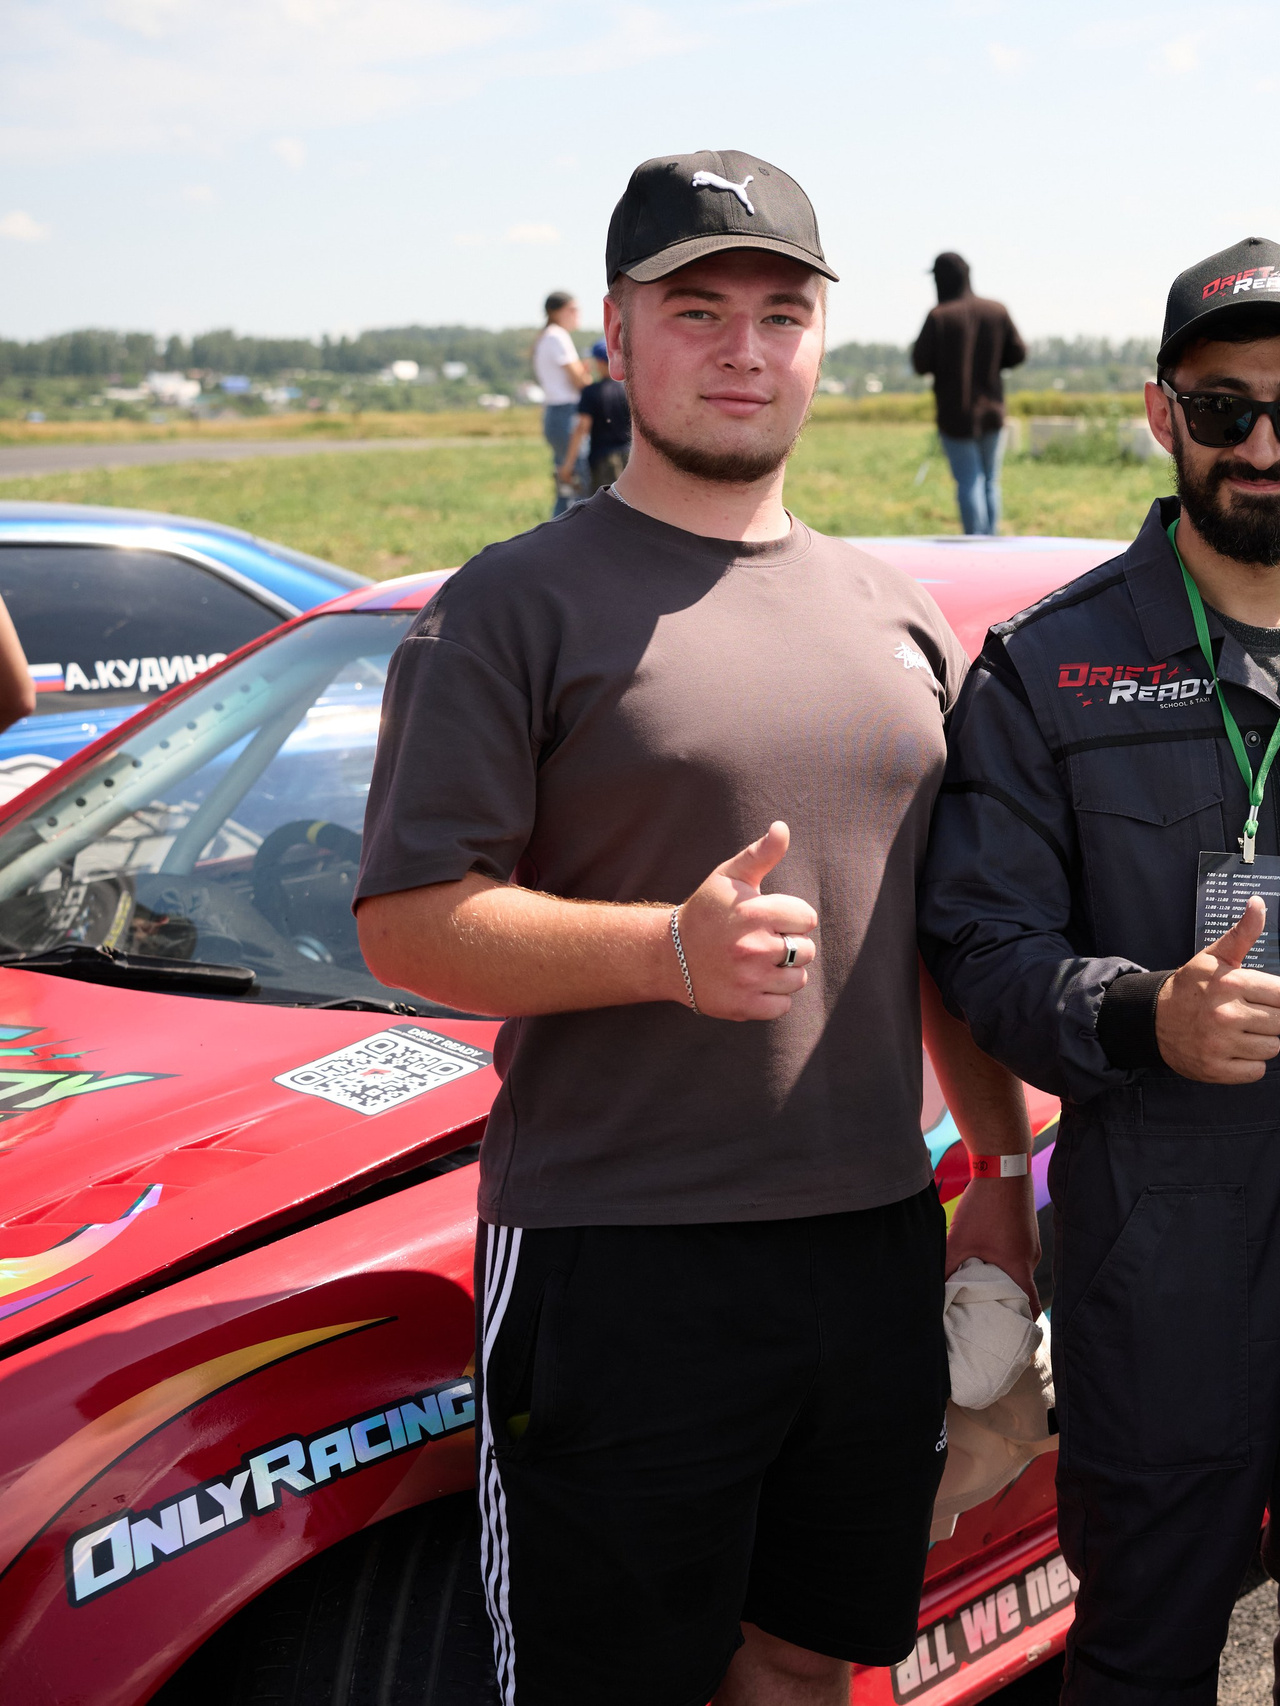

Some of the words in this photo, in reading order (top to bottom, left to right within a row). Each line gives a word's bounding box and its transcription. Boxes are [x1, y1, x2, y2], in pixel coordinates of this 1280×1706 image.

[1057, 662, 1167, 688] DRIFT
[1108, 678, 1220, 705] READY
[1159, 700, 1189, 710] SCHOOL
[1195, 697, 1211, 705] TAXI
[407, 1027, 443, 1043] DRIFT
[441, 1040, 484, 1058] READY
